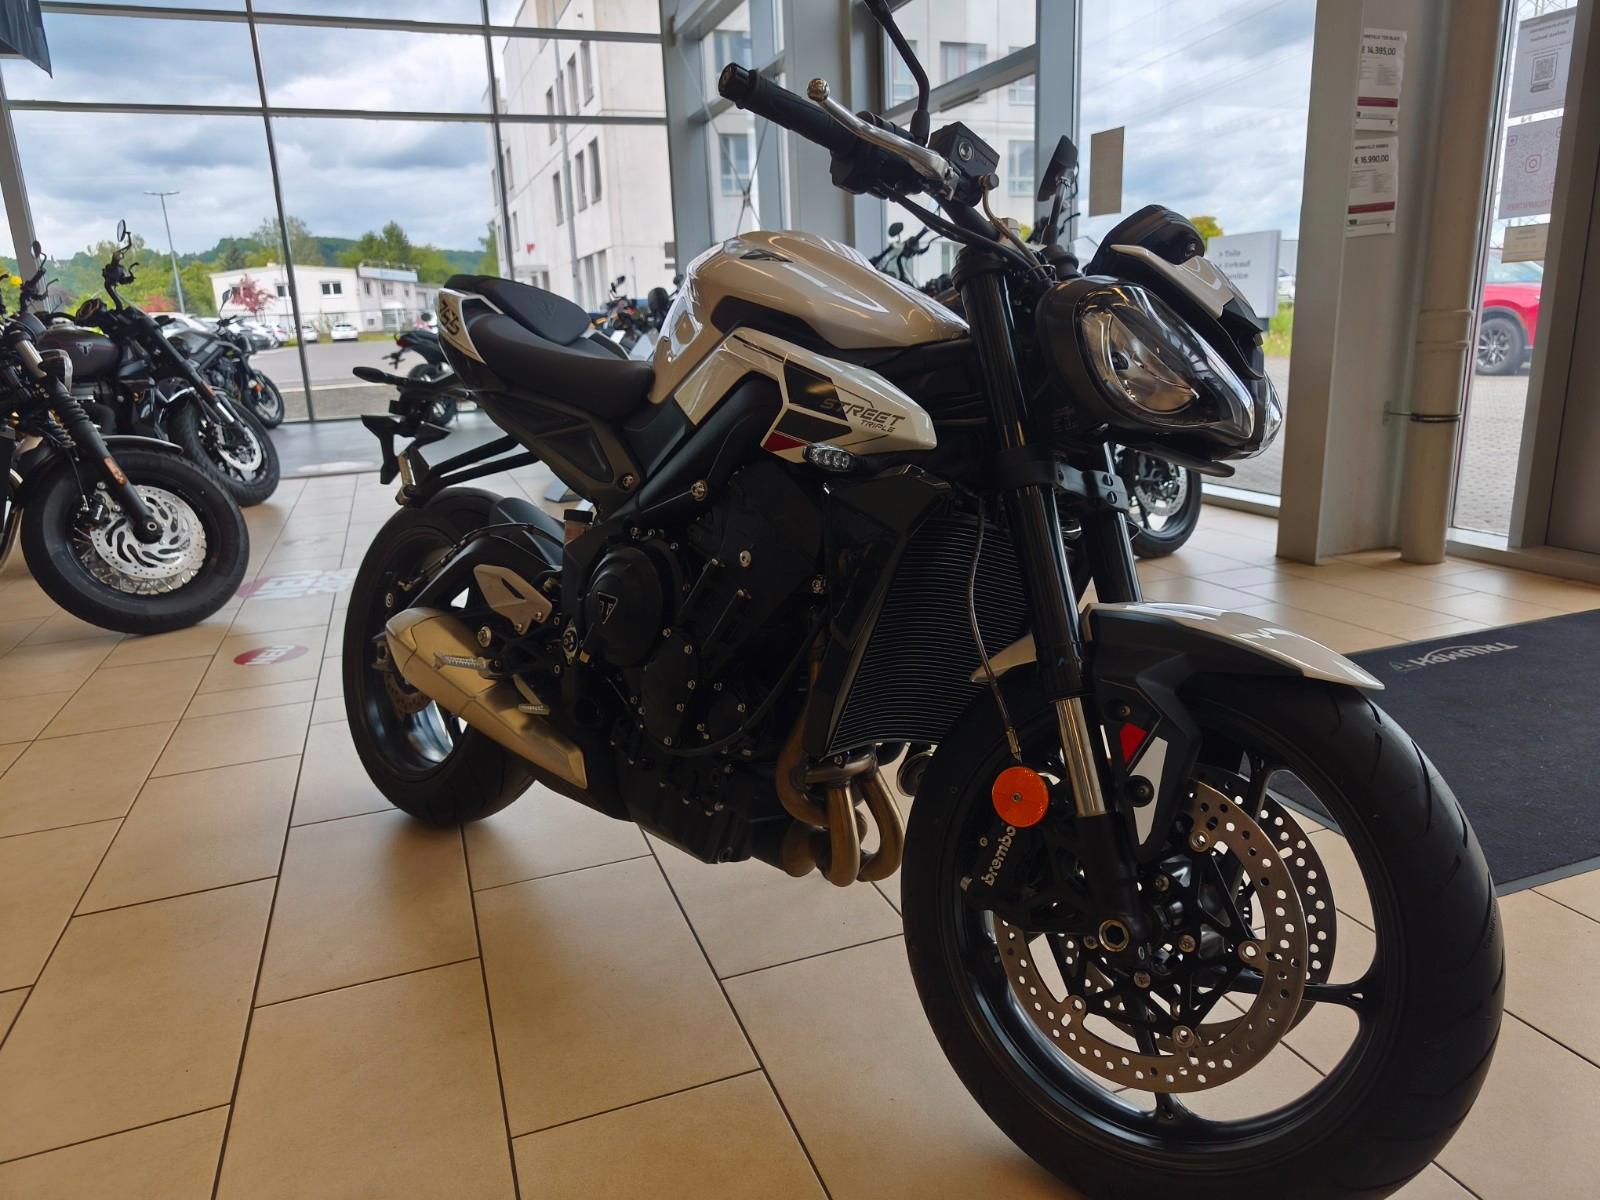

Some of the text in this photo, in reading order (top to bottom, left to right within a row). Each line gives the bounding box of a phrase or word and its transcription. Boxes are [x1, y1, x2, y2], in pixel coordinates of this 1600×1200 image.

[819, 398, 906, 427] STREET
[860, 419, 896, 433] TRIPLE
[1408, 642, 1519, 667] TRIUMPH
[980, 825, 1016, 887] brembo
